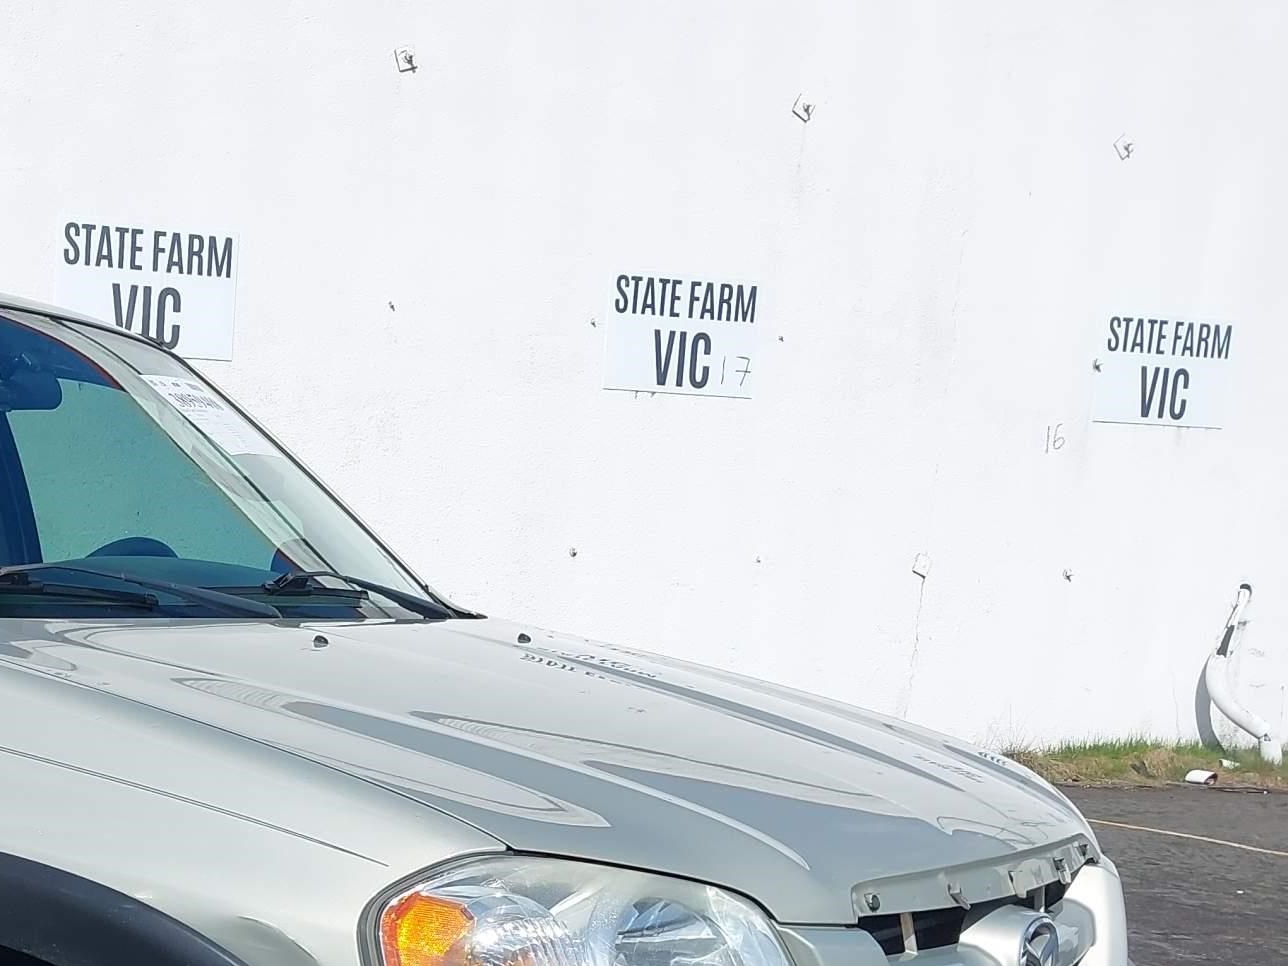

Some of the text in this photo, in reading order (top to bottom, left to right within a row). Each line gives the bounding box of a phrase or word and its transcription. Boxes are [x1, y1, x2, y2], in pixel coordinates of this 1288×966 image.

[64, 222, 233, 278] STATE FARM
[112, 283, 181, 350] VIC
[615, 274, 758, 323] STATE FARM
[654, 329, 712, 389] VIC
[1107, 316, 1233, 360] STATE FARM
[720, 355, 751, 386] 17
[1140, 366, 1190, 420] VIC
[1045, 423, 1065, 454] 16
